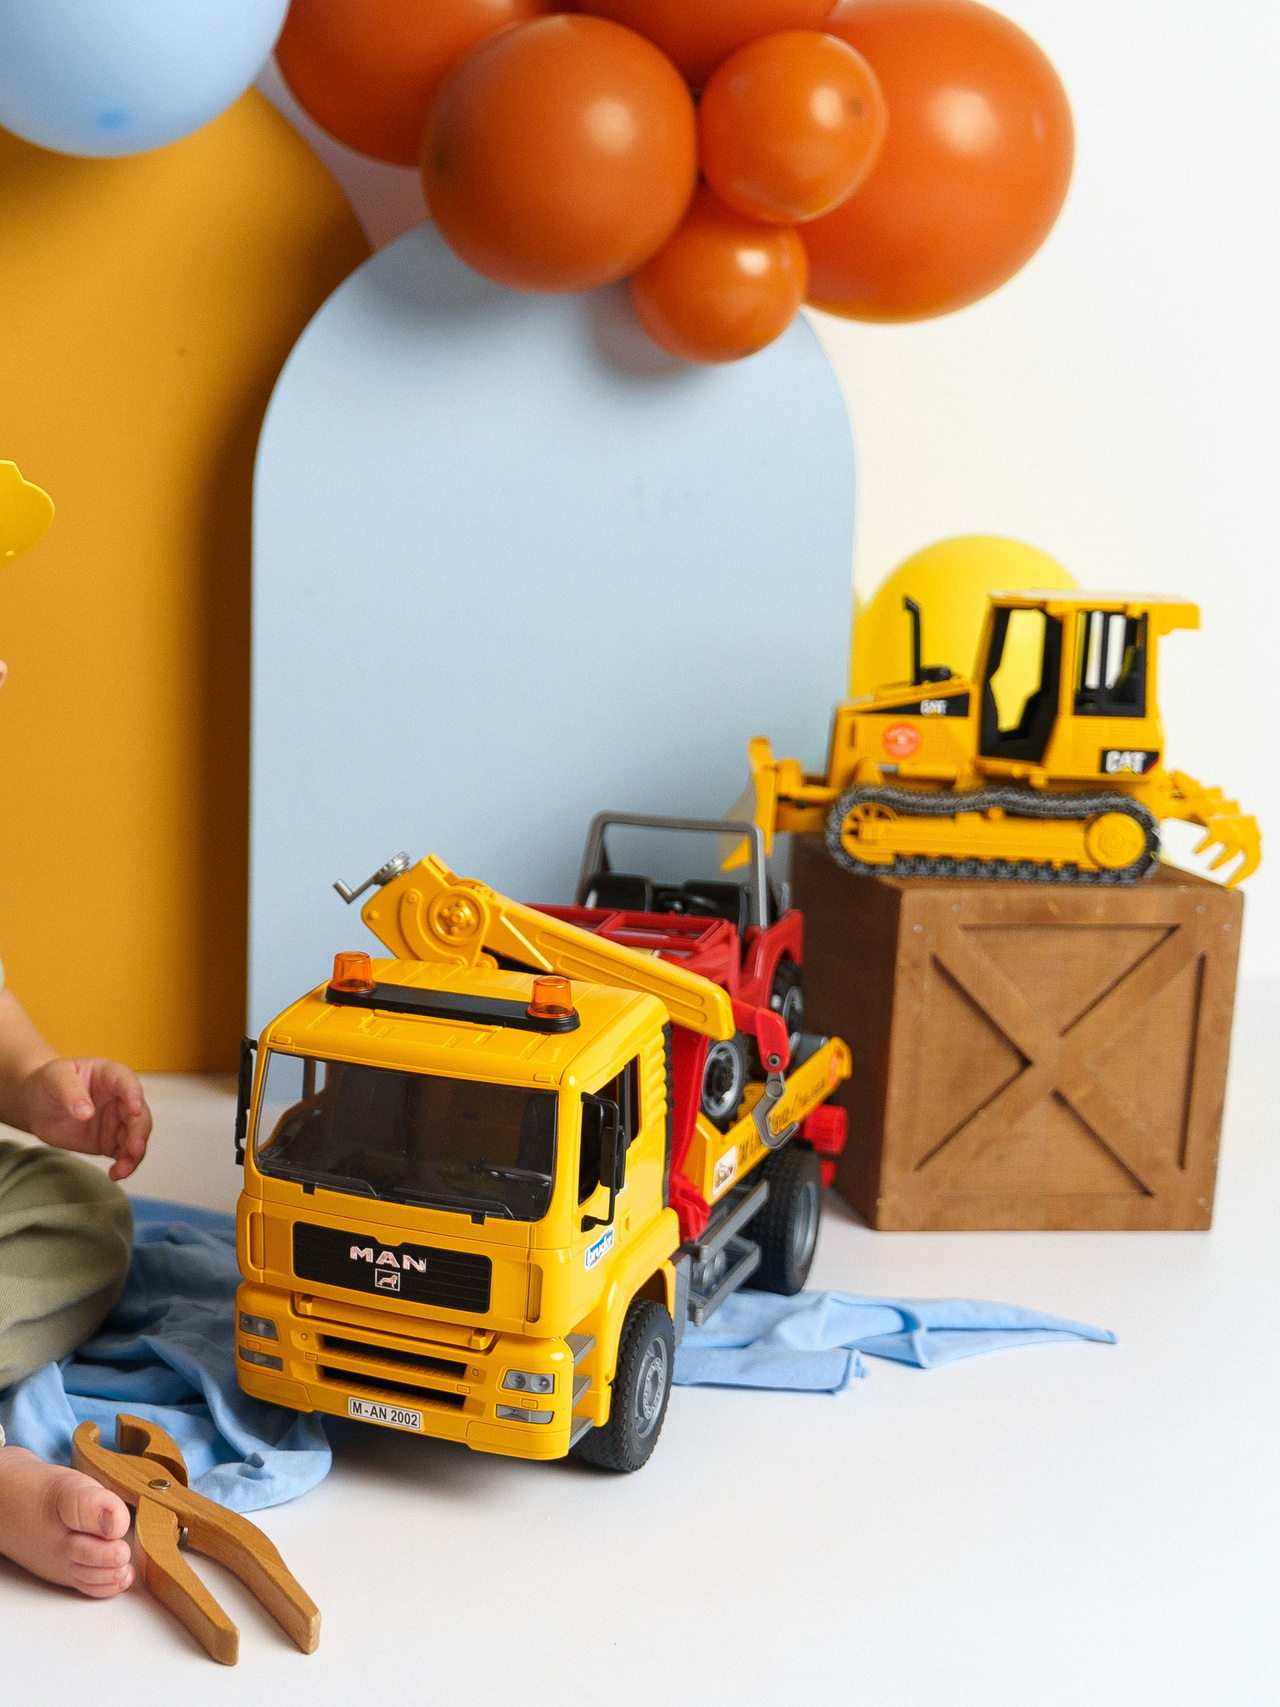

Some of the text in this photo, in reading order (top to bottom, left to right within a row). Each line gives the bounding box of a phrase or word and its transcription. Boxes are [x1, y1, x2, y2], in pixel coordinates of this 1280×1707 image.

[1106, 750, 1147, 775] CAT
[349, 1245, 427, 1273] MAN
[390, 1409, 418, 1427] 2002
